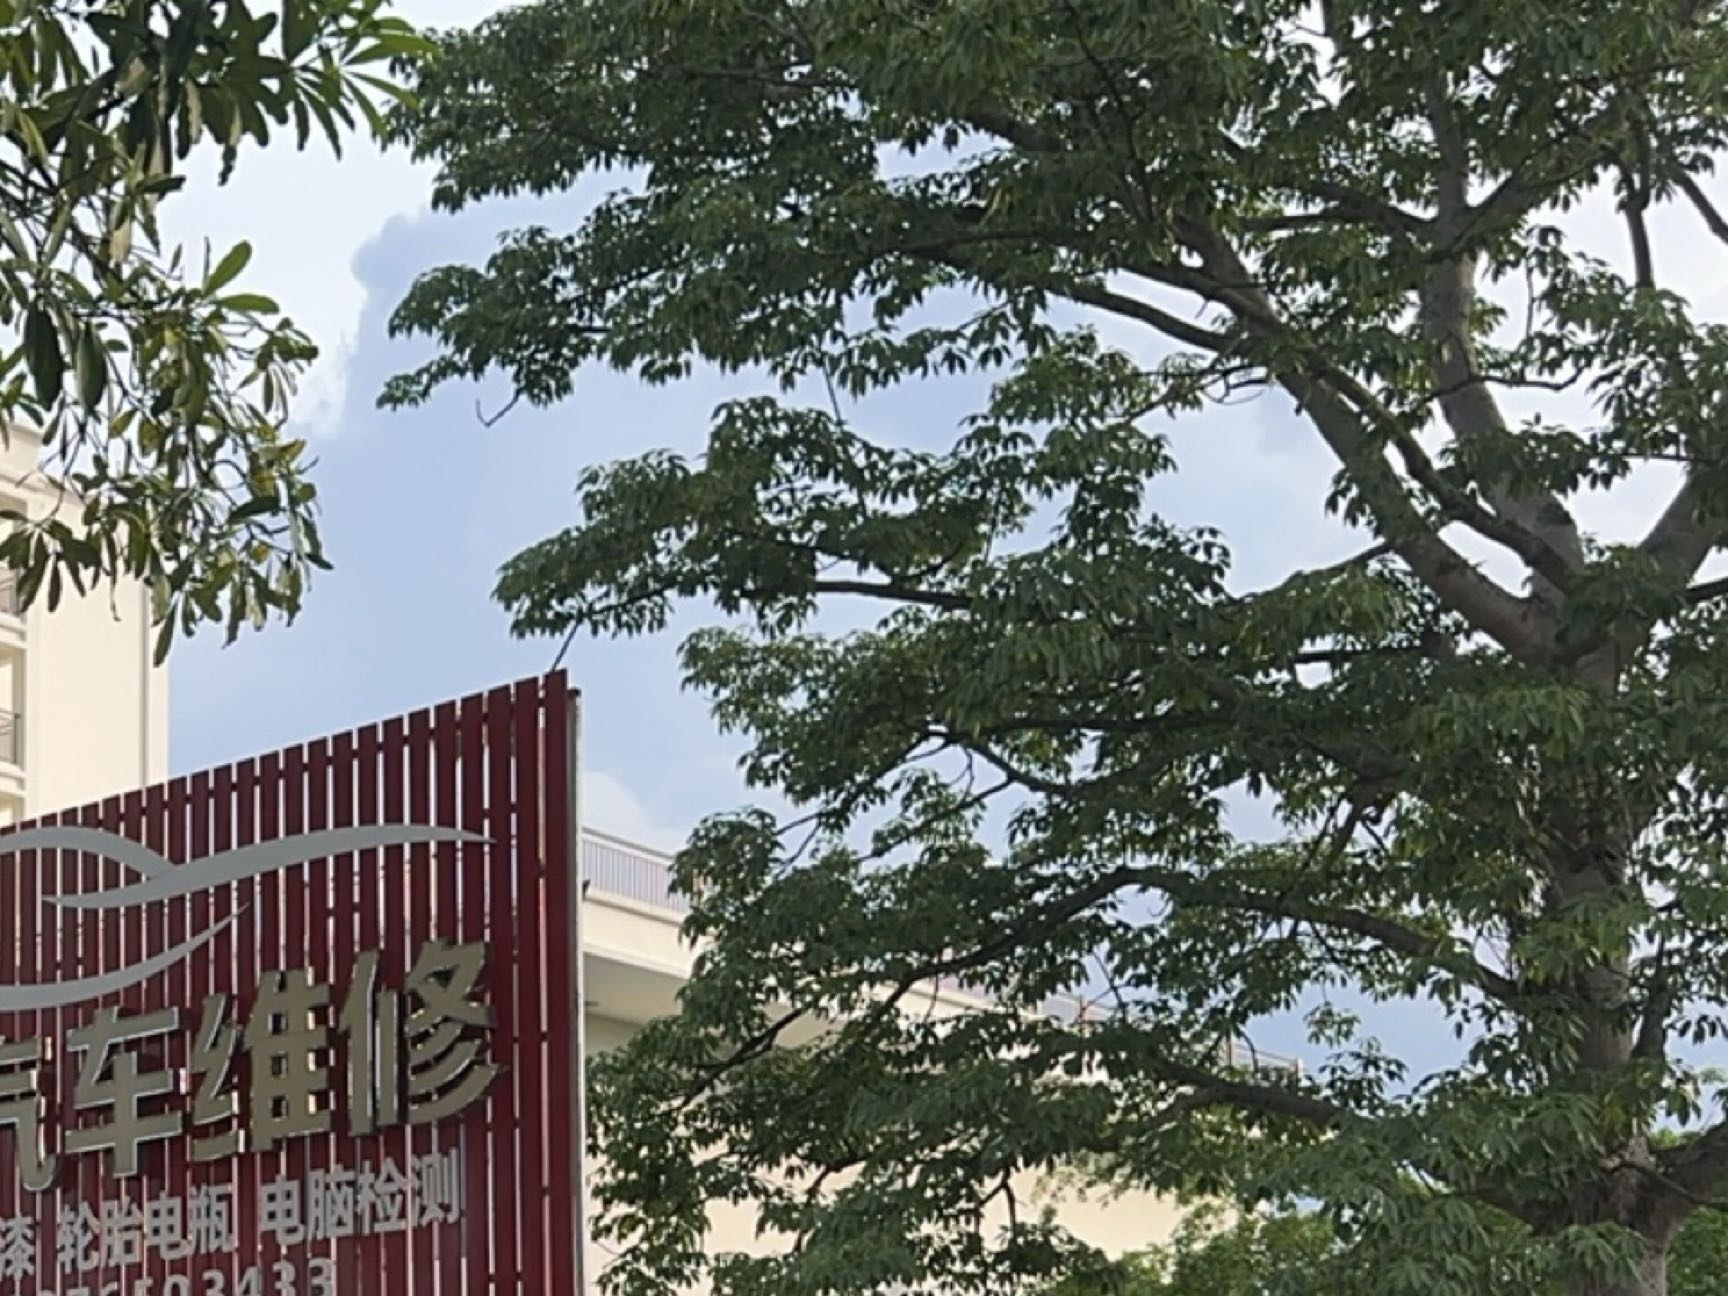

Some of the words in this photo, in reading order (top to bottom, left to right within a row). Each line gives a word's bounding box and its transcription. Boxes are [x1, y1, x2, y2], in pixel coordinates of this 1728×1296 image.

[57, 1182, 238, 1275] 轮胎电瓶
[260, 1148, 461, 1247] 电脑检测
